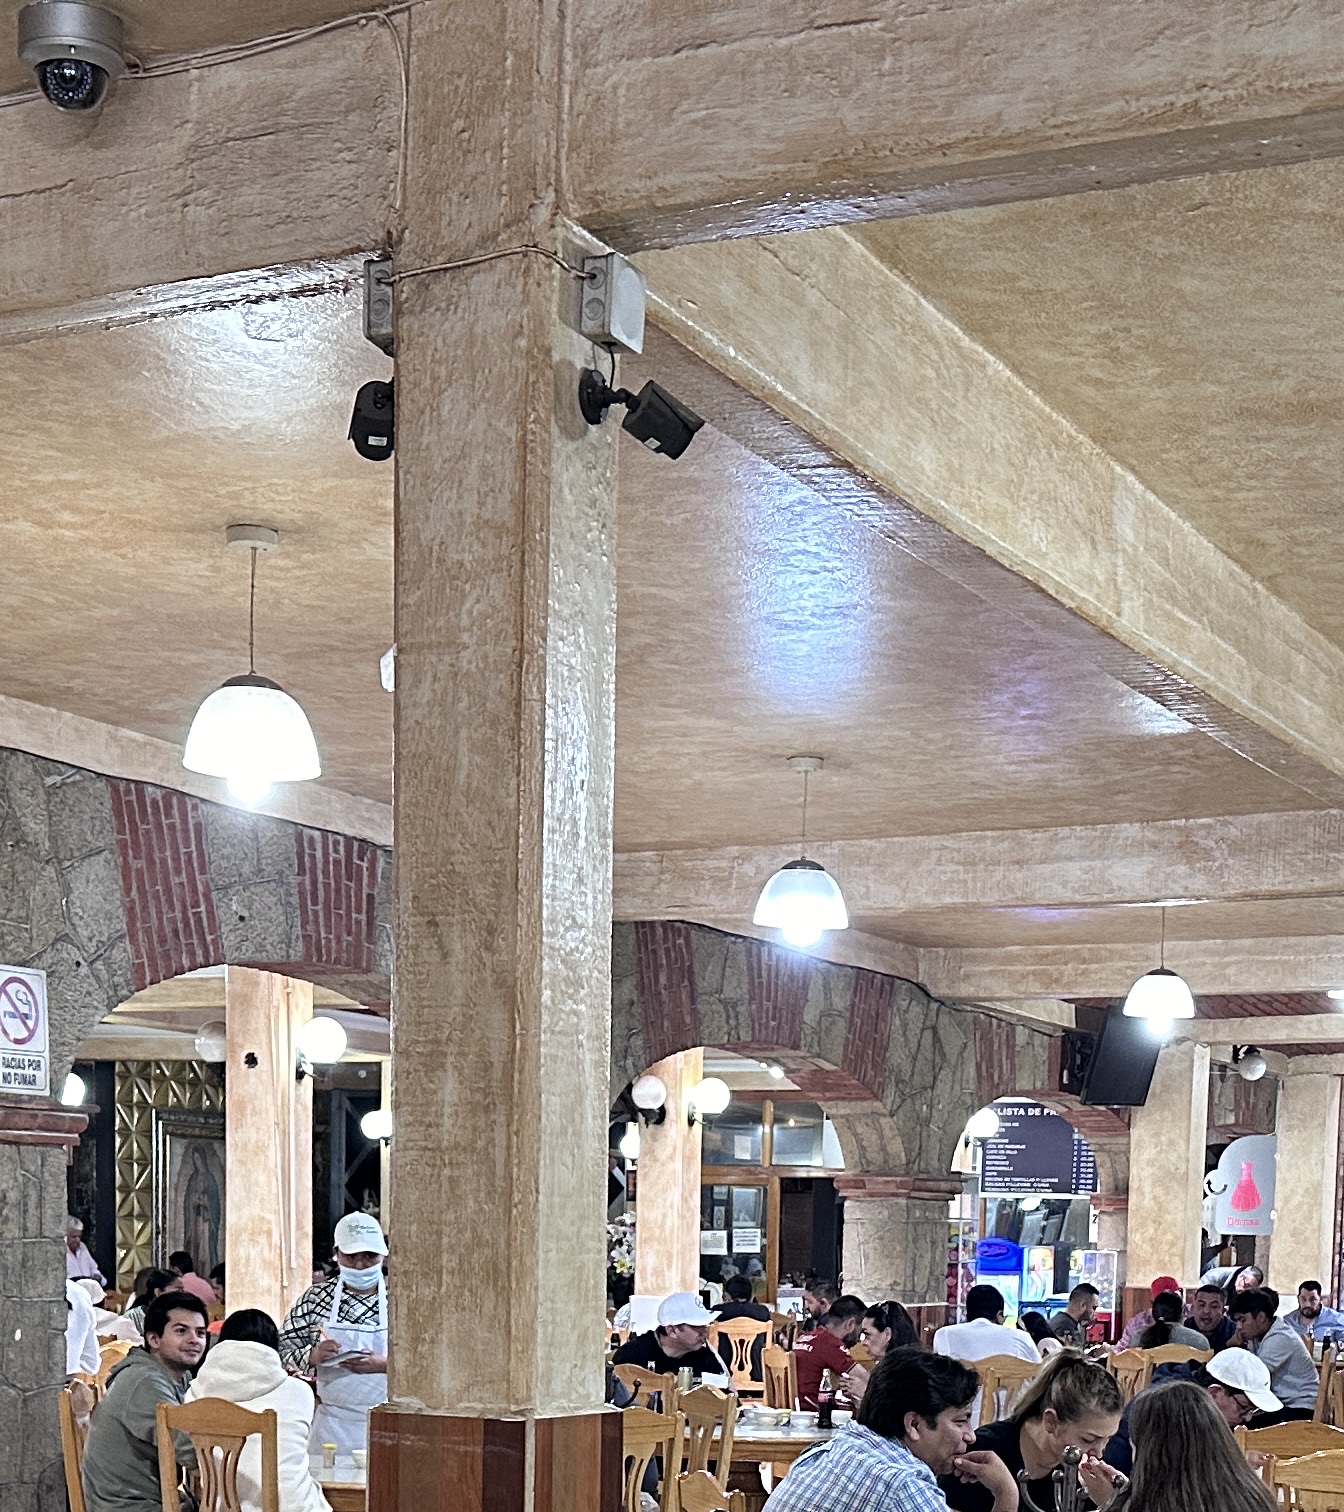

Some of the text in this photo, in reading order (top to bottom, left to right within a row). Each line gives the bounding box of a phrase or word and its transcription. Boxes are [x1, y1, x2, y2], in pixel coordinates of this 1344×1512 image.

[2, 1056, 41, 1071] RACIAS POR
[2, 1072, 37, 1086] NO FUMAR
[997, 1107, 1026, 1116] LISTA
[1027, 1107, 1042, 1116] DE
